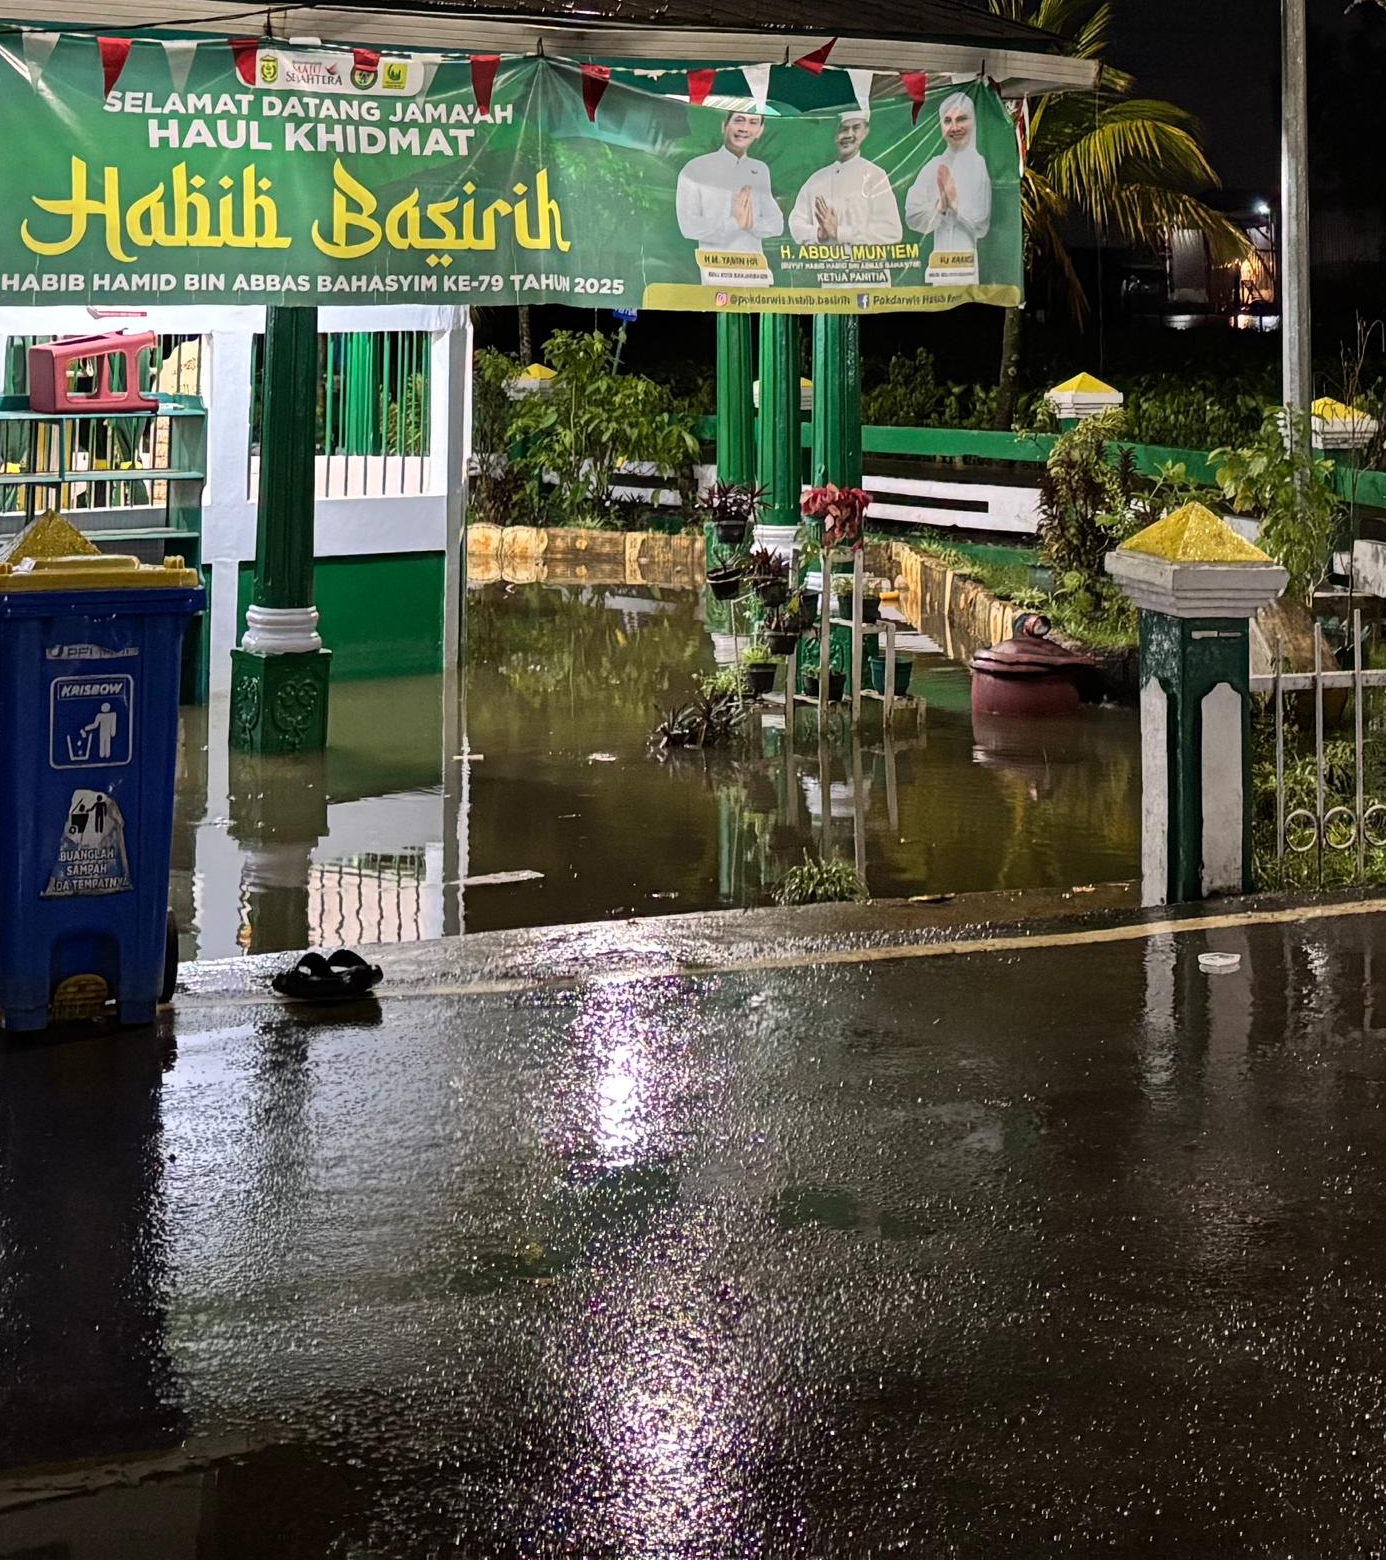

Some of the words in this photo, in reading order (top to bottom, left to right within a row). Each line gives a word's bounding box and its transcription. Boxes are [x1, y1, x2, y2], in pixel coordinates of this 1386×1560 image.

[103, 90, 254, 117] SELAMAT
[263, 96, 380, 122] DATANG
[148, 118, 273, 151] HAUL
[284, 122, 476, 157] KHIDMAT
[20, 154, 293, 263] Habib
[311, 156, 572, 269] Basirih
[780, 245, 795, 259] H.
[799, 244, 850, 259] ABDUL
[853, 243, 919, 260] MUN'IEM
[1, 273, 85, 292] HABIB
[92, 273, 177, 292] HAMID
[184, 273, 225, 292] BIN
[233, 273, 311, 293] ABBAS
[317, 274, 438, 293] BAHASYIM
[443, 275, 504, 294] KE-79
[510, 274, 570, 294] TAHUN
[573, 277, 625, 296] 2025
[817, 272, 849, 283] KETUA
[850, 272, 888, 283] PANITIA
[61, 683, 123, 697] KRISBOW
[60, 849, 115, 862] BUANGLAH
[66, 864, 107, 876] SAMPAH
